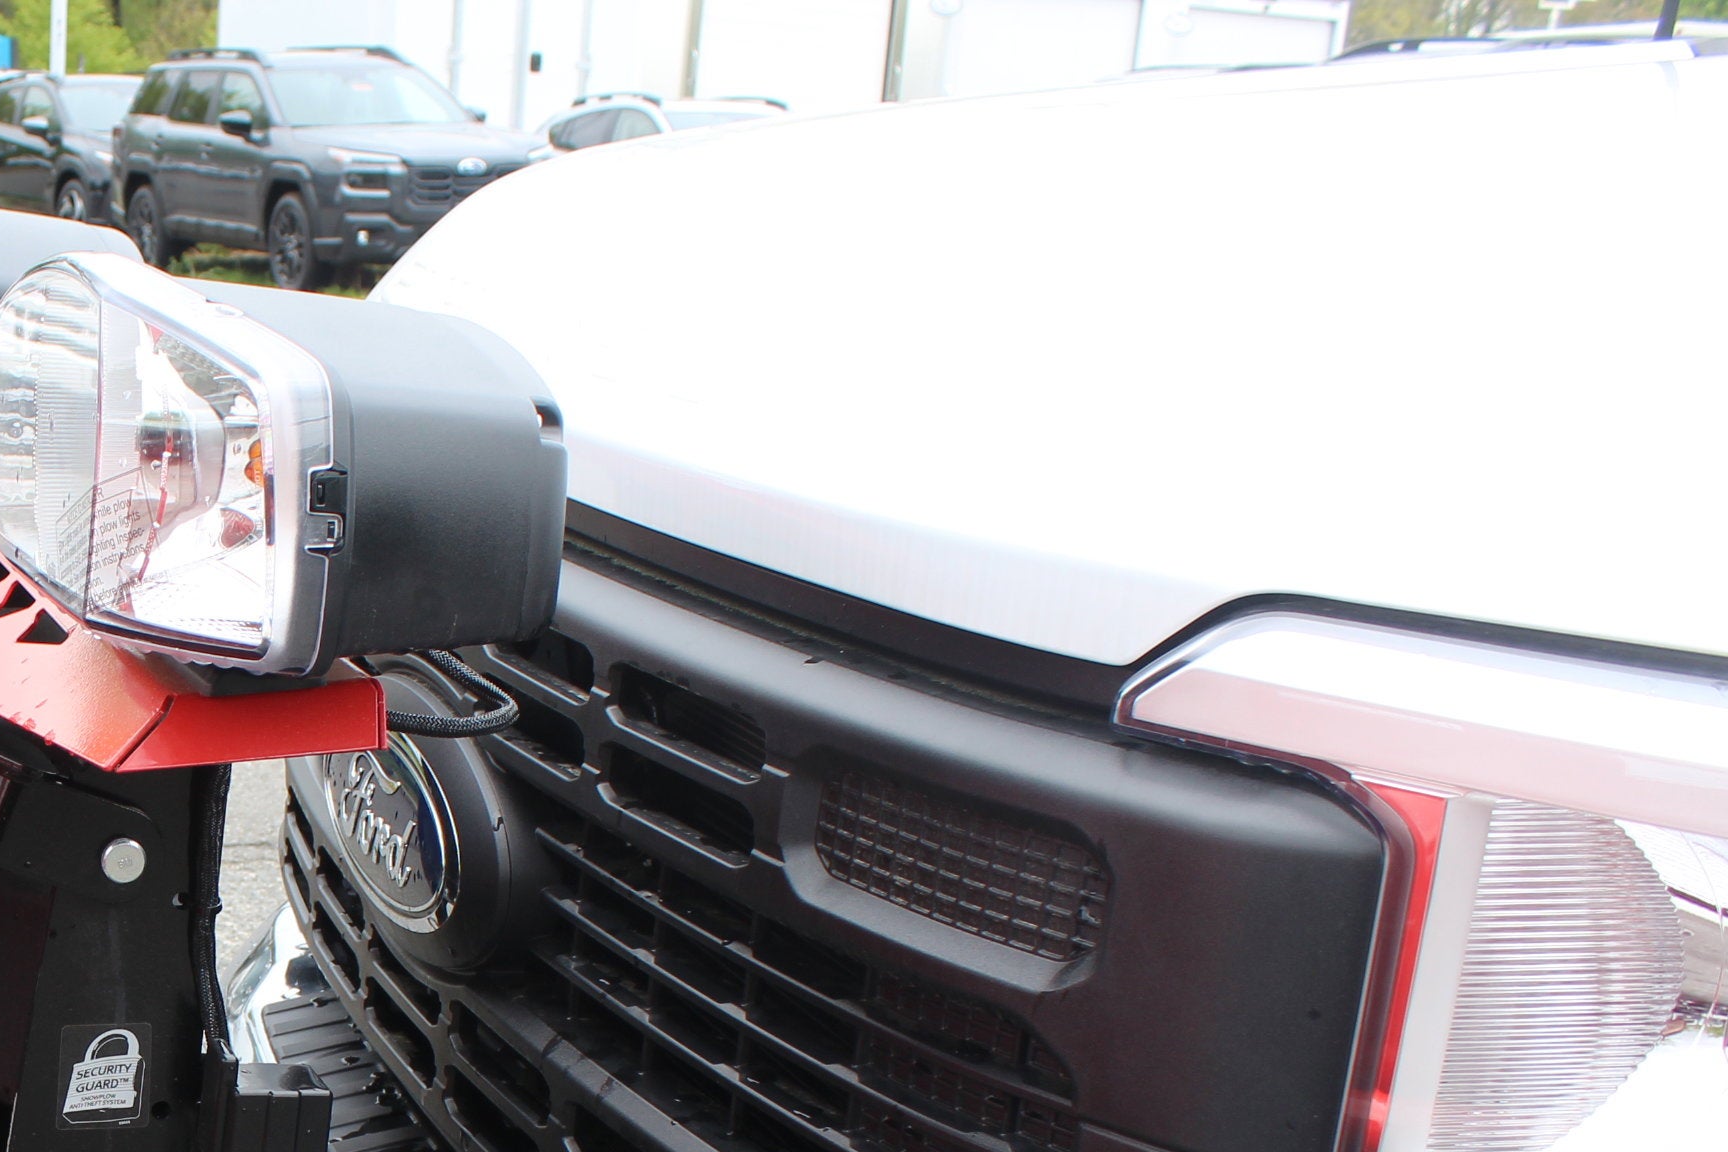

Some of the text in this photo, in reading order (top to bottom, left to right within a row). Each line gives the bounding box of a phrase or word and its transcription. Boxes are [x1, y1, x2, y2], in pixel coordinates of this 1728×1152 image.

[100, 520, 117, 537] plow
[341, 750, 416, 888] Ford
[76, 1063, 132, 1080] SECURITY
[81, 1093, 116, 1102] SNOWPLOW
